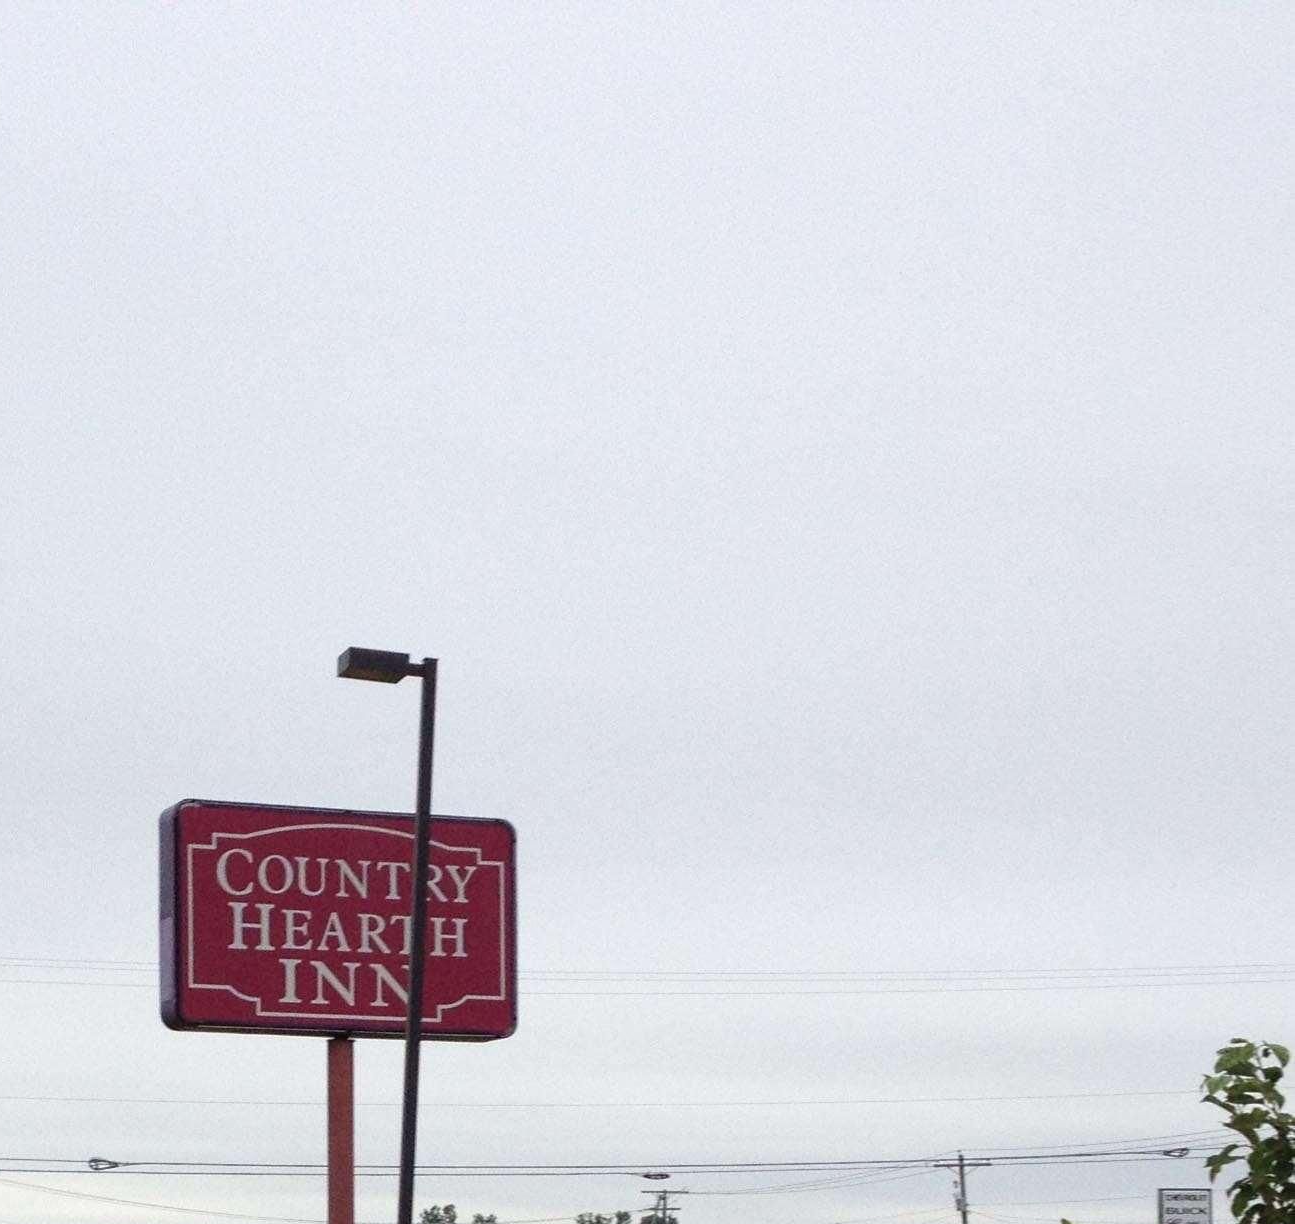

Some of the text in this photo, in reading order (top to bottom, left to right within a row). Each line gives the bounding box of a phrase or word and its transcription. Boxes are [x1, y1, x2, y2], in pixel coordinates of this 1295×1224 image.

[215, 847, 478, 904] COUNTRY
[226, 901, 469, 958] HEARTH
[278, 957, 414, 1008] INN
